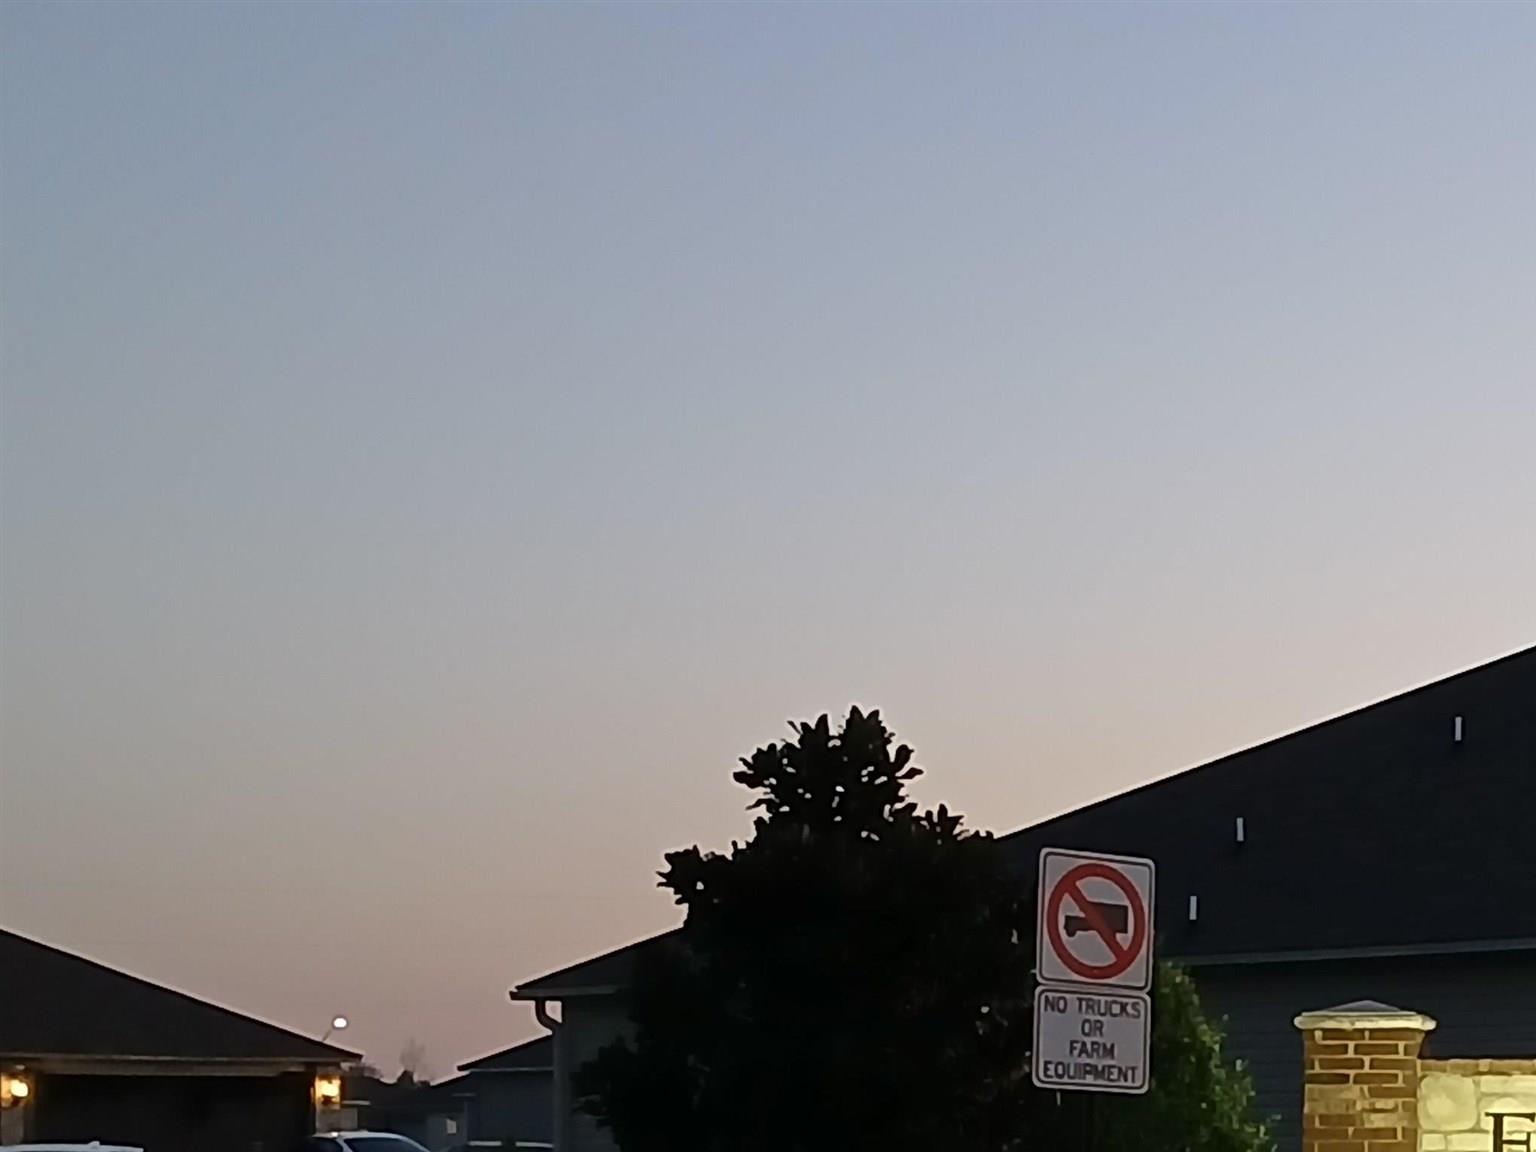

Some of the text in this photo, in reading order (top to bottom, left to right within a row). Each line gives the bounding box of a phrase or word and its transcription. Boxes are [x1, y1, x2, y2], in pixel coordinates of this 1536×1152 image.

[1043, 995, 1141, 1018] NO TRUCKS
[1081, 1018, 1104, 1037] OR
[1069, 1039, 1115, 1060] FARM
[1043, 1060, 1137, 1083] EQUIPMENT
